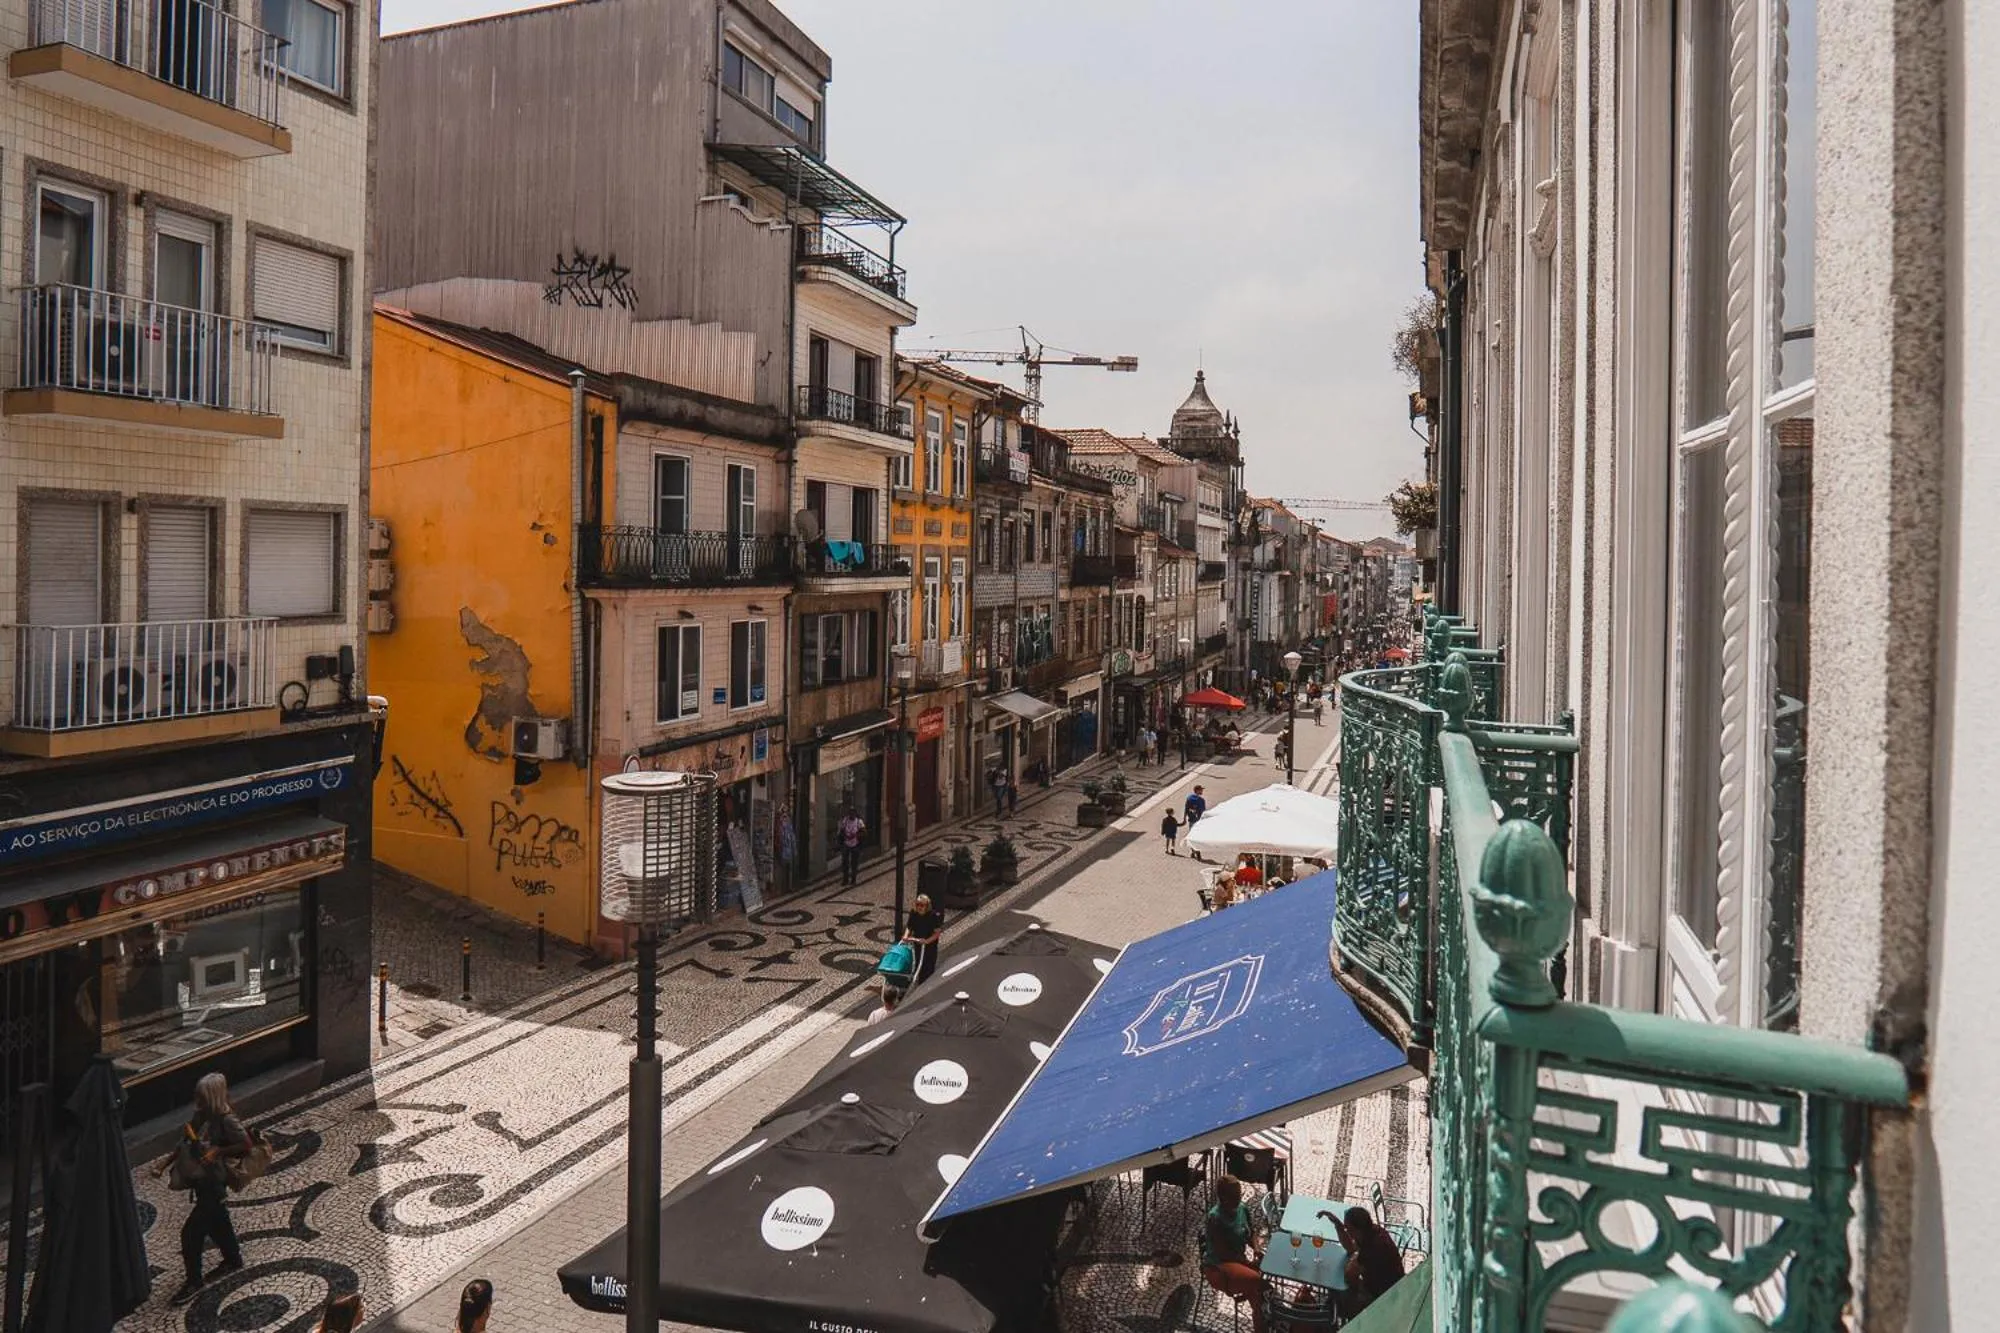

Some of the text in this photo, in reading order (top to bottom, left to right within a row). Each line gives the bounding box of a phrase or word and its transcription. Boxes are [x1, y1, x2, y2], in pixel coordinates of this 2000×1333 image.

[11, 778, 313, 850] AO SERVIÇO DA ELECTRÓNICA E DO PROGRESSO
[113, 833, 345, 905] COMPONENTES
[920, 1075, 962, 1088] bellissimo
[771, 1207, 824, 1227] bellissimo
[591, 1275, 627, 1297] belliss
[809, 1319, 819, 1330] IL
[821, 1322, 852, 1333] GUSTO
